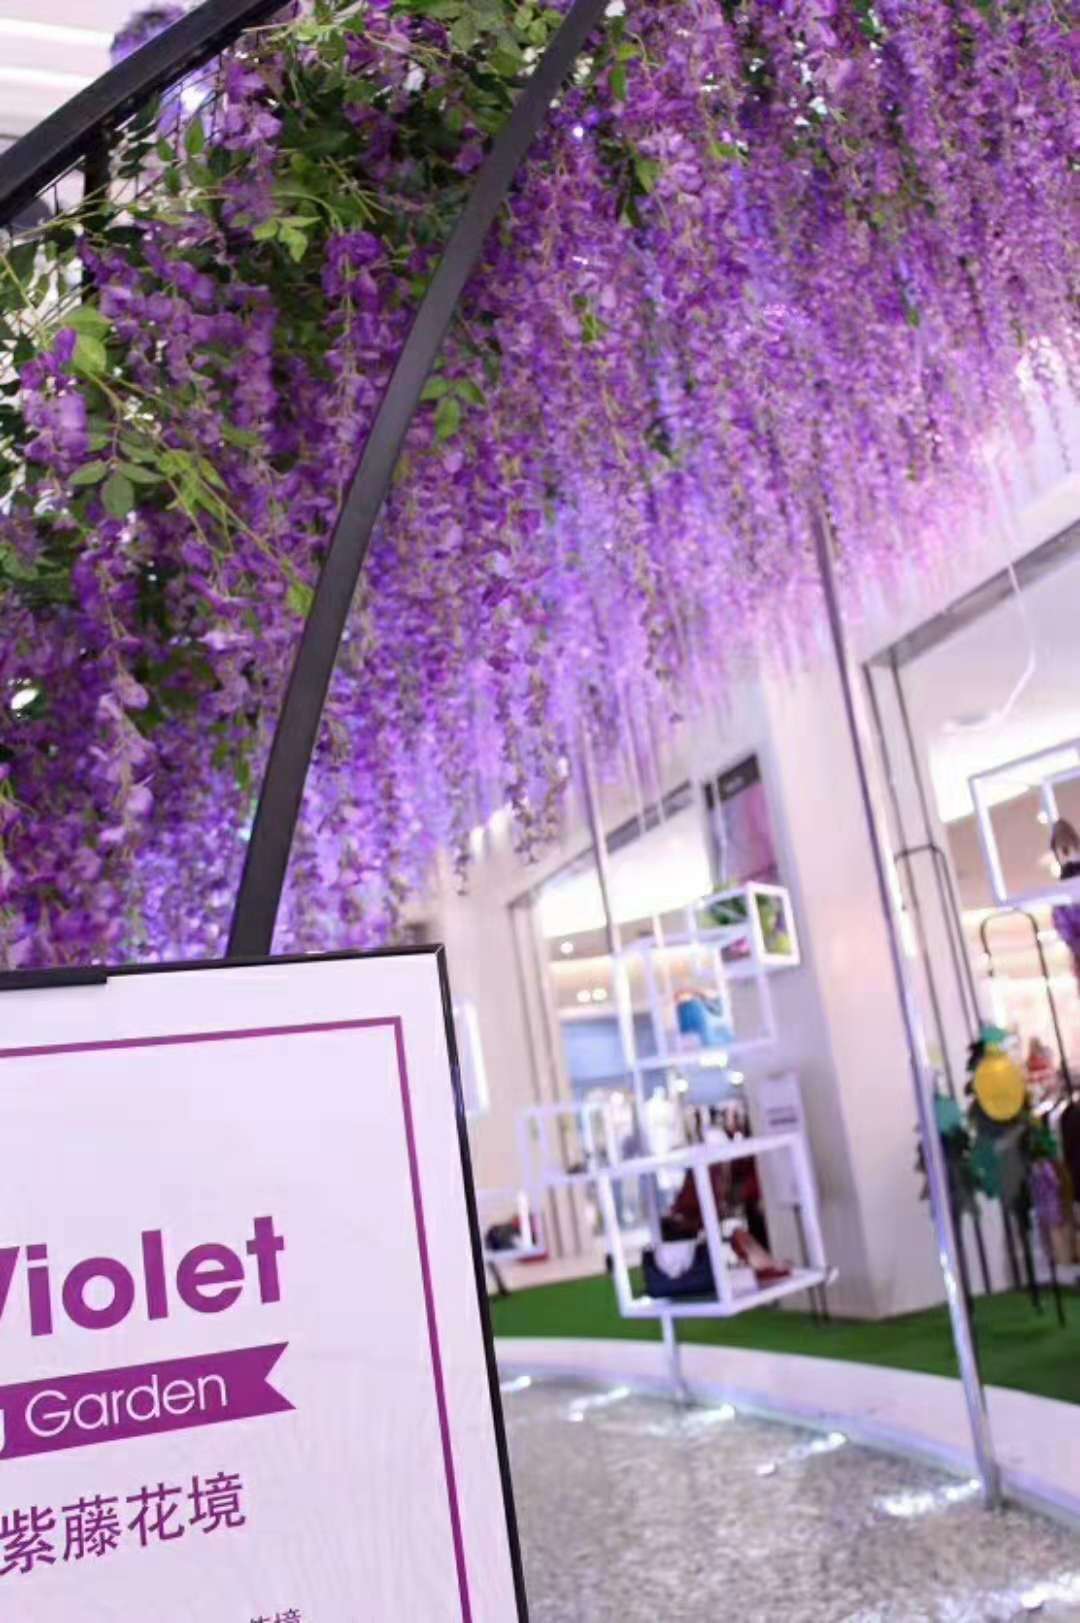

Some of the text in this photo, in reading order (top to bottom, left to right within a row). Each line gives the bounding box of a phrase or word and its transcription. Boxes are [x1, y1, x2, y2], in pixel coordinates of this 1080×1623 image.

[25, 1374, 228, 1438] Garden
[0, 1471, 246, 1576] 紫藤花境
